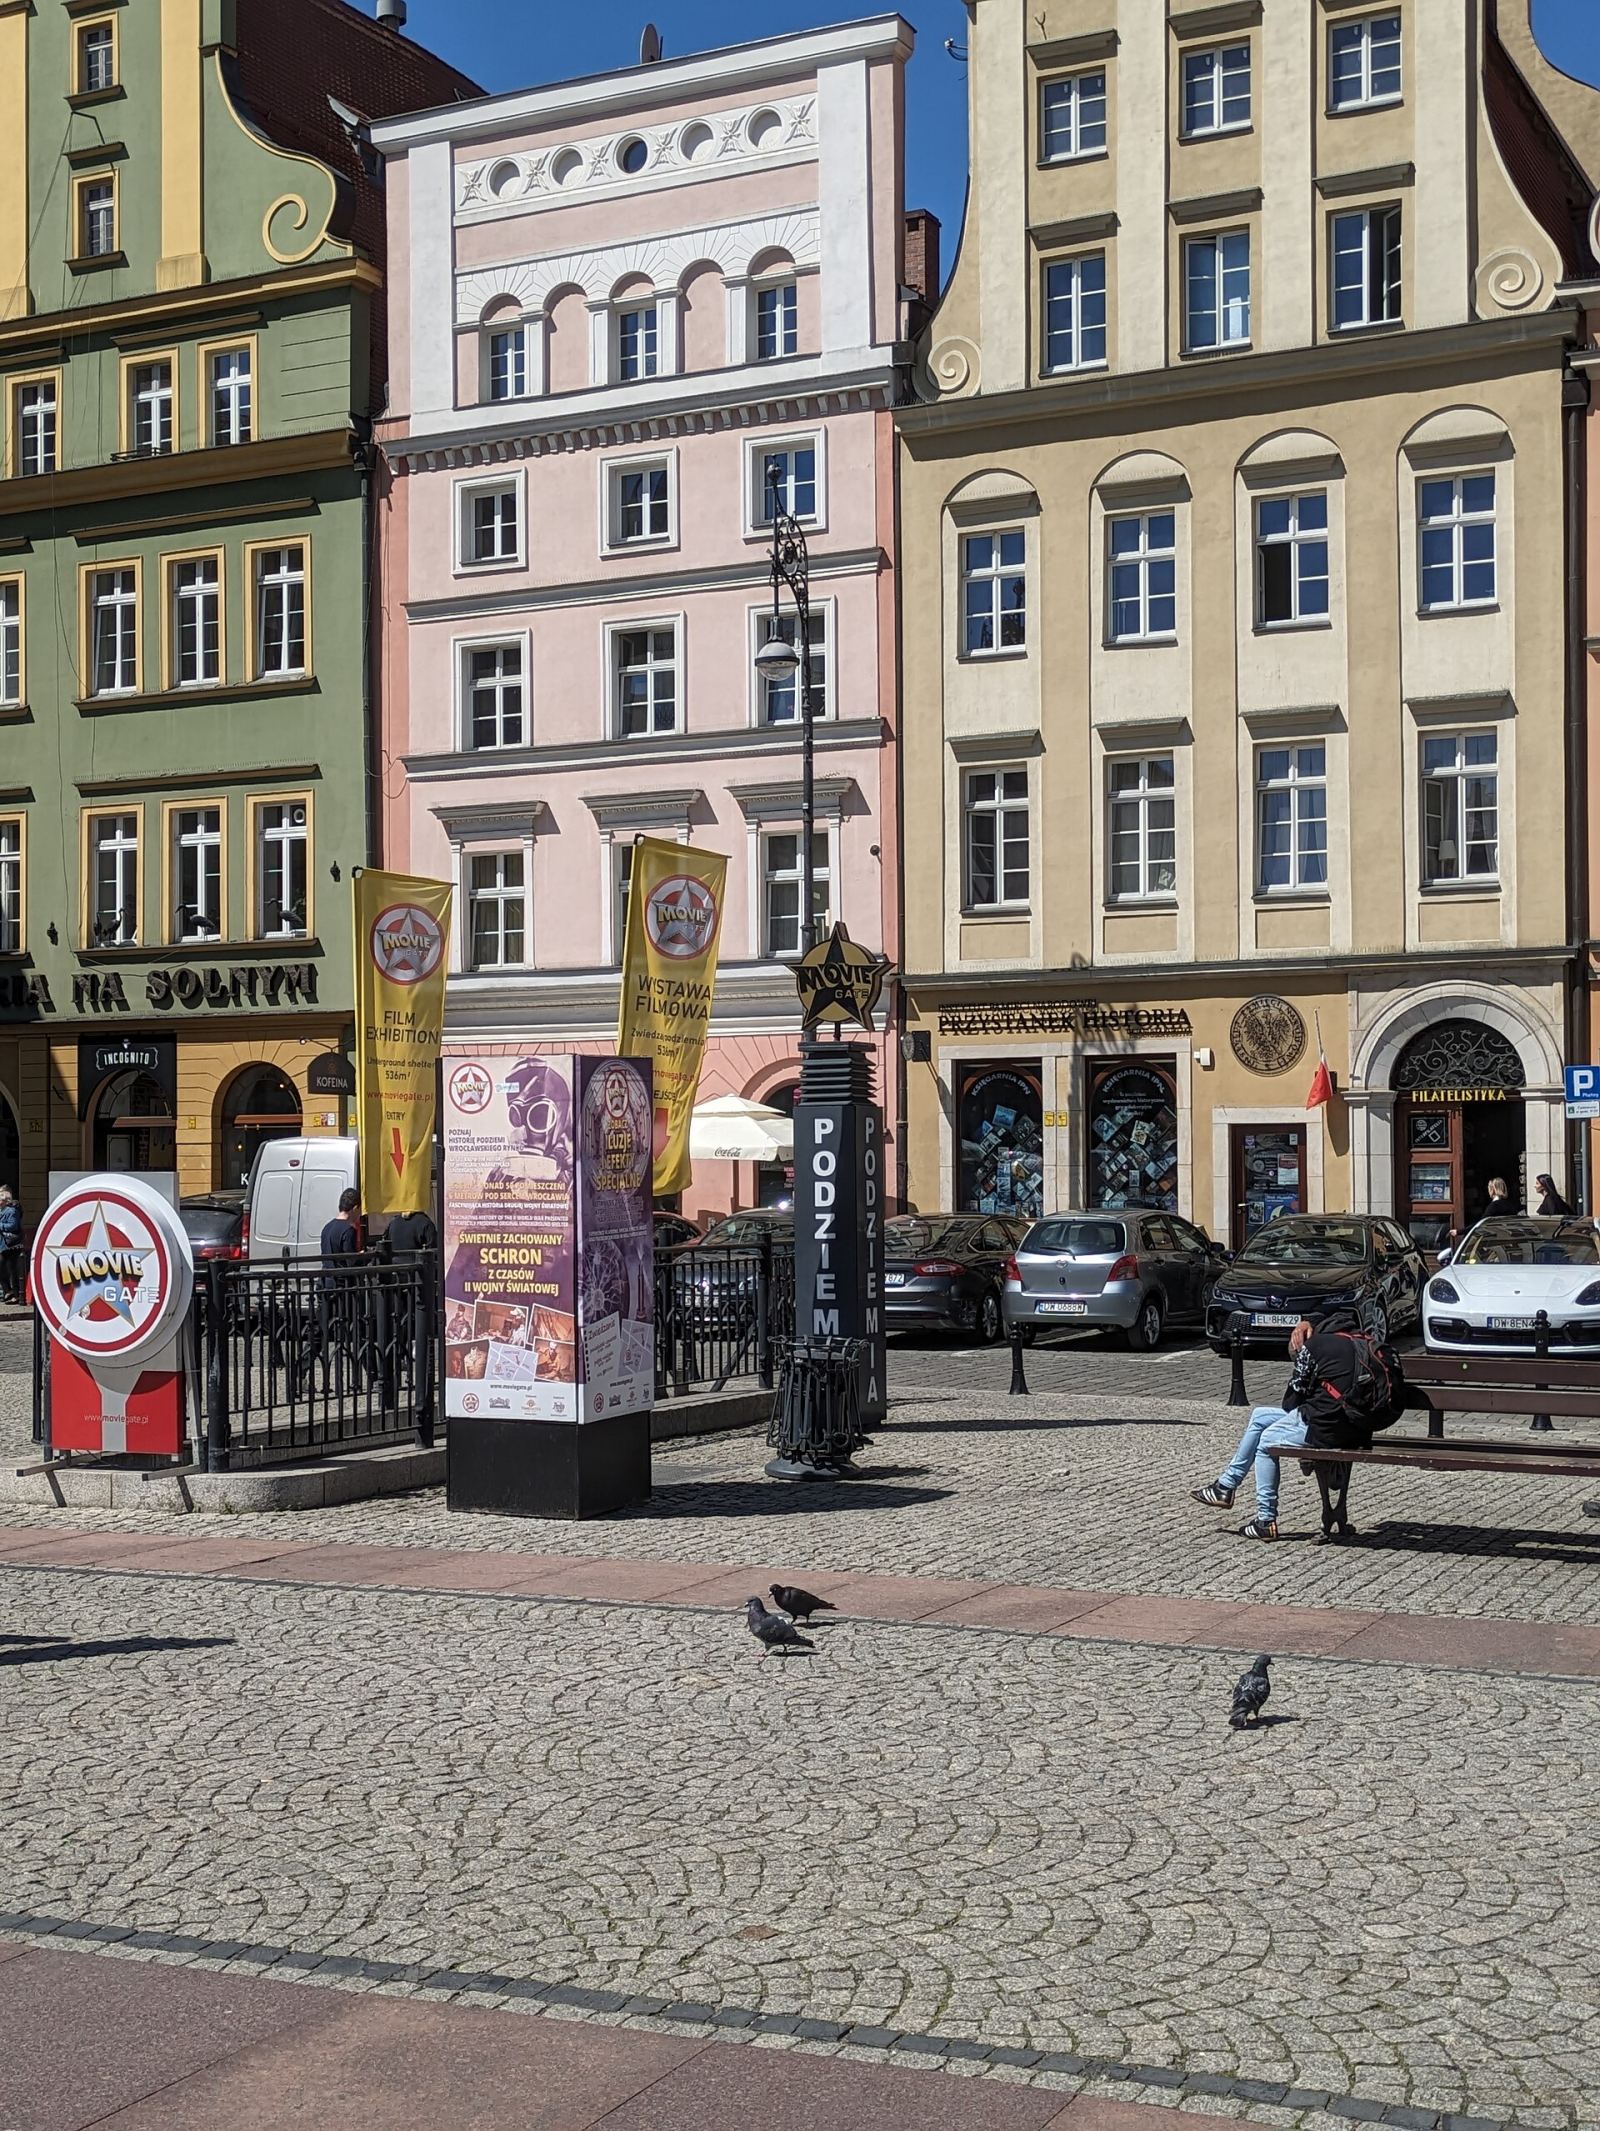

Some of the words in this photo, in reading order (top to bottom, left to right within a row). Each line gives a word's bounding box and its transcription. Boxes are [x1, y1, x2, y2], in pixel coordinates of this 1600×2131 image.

[657, 905, 708, 922] MOVIE
[384, 933, 432, 950] MOVIE
[72, 972, 126, 1004] NA
[146, 962, 316, 1000] SOLNYM
[801, 962, 872, 994] MOVIE
[834, 988, 869, 999] GATE
[384, 1010, 416, 1026] FILM
[938, 1012, 1075, 1033] PRZYSTANEK
[1083, 1008, 1193, 1030] HISTORIA
[366, 1026, 439, 1045] EXHIBITION
[104, 1052, 151, 1066] INCOGNITO
[316, 1076, 348, 1089] KOFEINA
[1573, 1070, 1594, 1097] P
[1412, 1089, 1507, 1103] FILATELISTYKA
[596, 1173, 641, 1193] SPECJALNE
[485, 1192, 499, 1200] POD
[812, 1118, 839, 1335] PODZIEM
[460, 1231, 501, 1244] ŚWIETNIE
[503, 1233, 563, 1245] ZACHOWANY
[480, 1248, 542, 1265] SCHRON
[864, 1117, 879, 1403] PODZIEMIA
[59, 1251, 143, 1285] MOVIE
[488, 1269, 496, 1280] Z
[496, 1267, 534, 1281] CZASÓW
[104, 1286, 160, 1303] GATE
[464, 1282, 471, 1292] II
[472, 1282, 505, 1294] WOJNY
[506, 1281, 559, 1297] ŚWIATOWEJ
[1257, 1315, 1268, 1324] EL
[1271, 1315, 1299, 1325] 8HK29
[1494, 1318, 1507, 1328] DW
[1510, 1318, 1536, 1329] 8EN4
[490, 1383, 533, 1391] www.moviegate.pl
[84, 1413, 149, 1425] www.moviegate.pl
